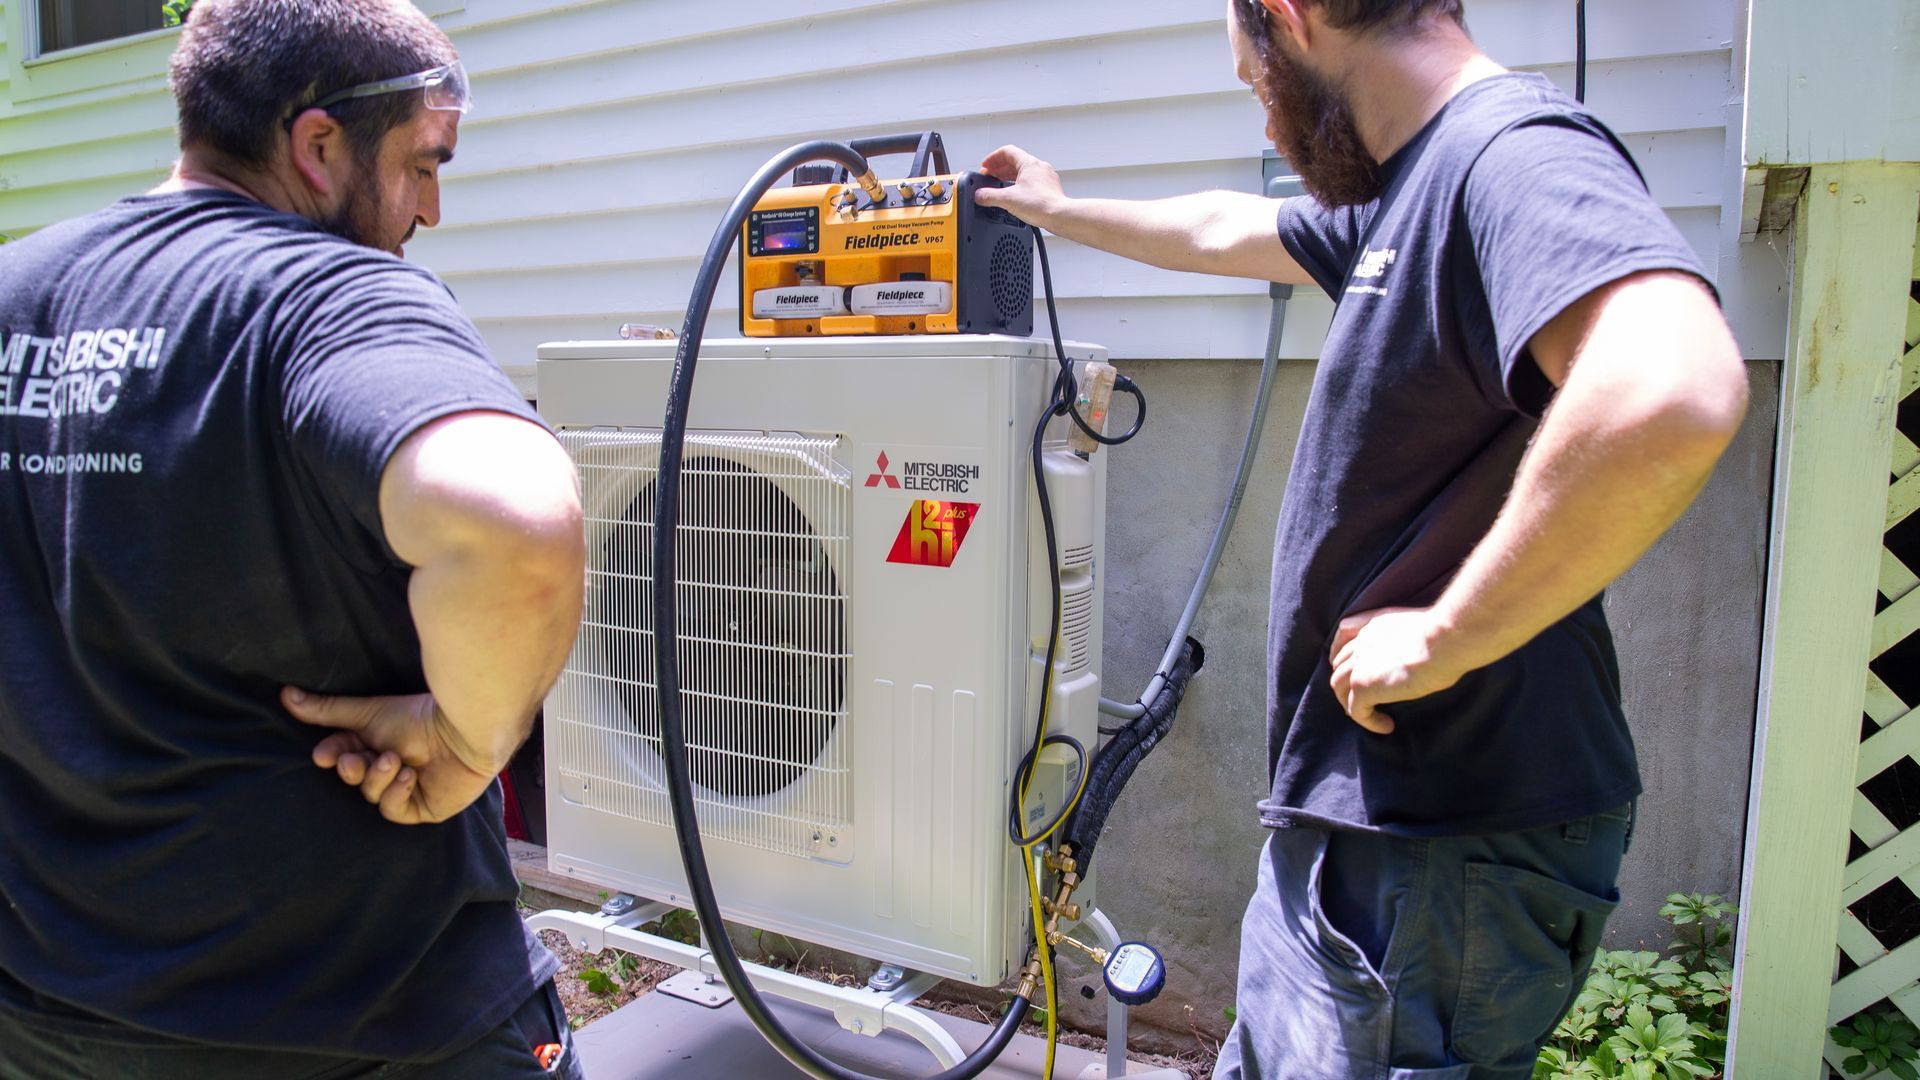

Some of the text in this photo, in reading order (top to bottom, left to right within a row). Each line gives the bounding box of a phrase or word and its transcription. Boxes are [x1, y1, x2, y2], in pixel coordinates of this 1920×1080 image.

[845, 233, 919, 250] Fieldpiece
[776, 295, 819, 304] Fieldpiece
[877, 291, 924, 301] Fieldpiece
[904, 462, 979, 479] MITSUBISHI
[904, 476, 969, 493] ELECTRIC
[943, 507, 967, 520] plus
